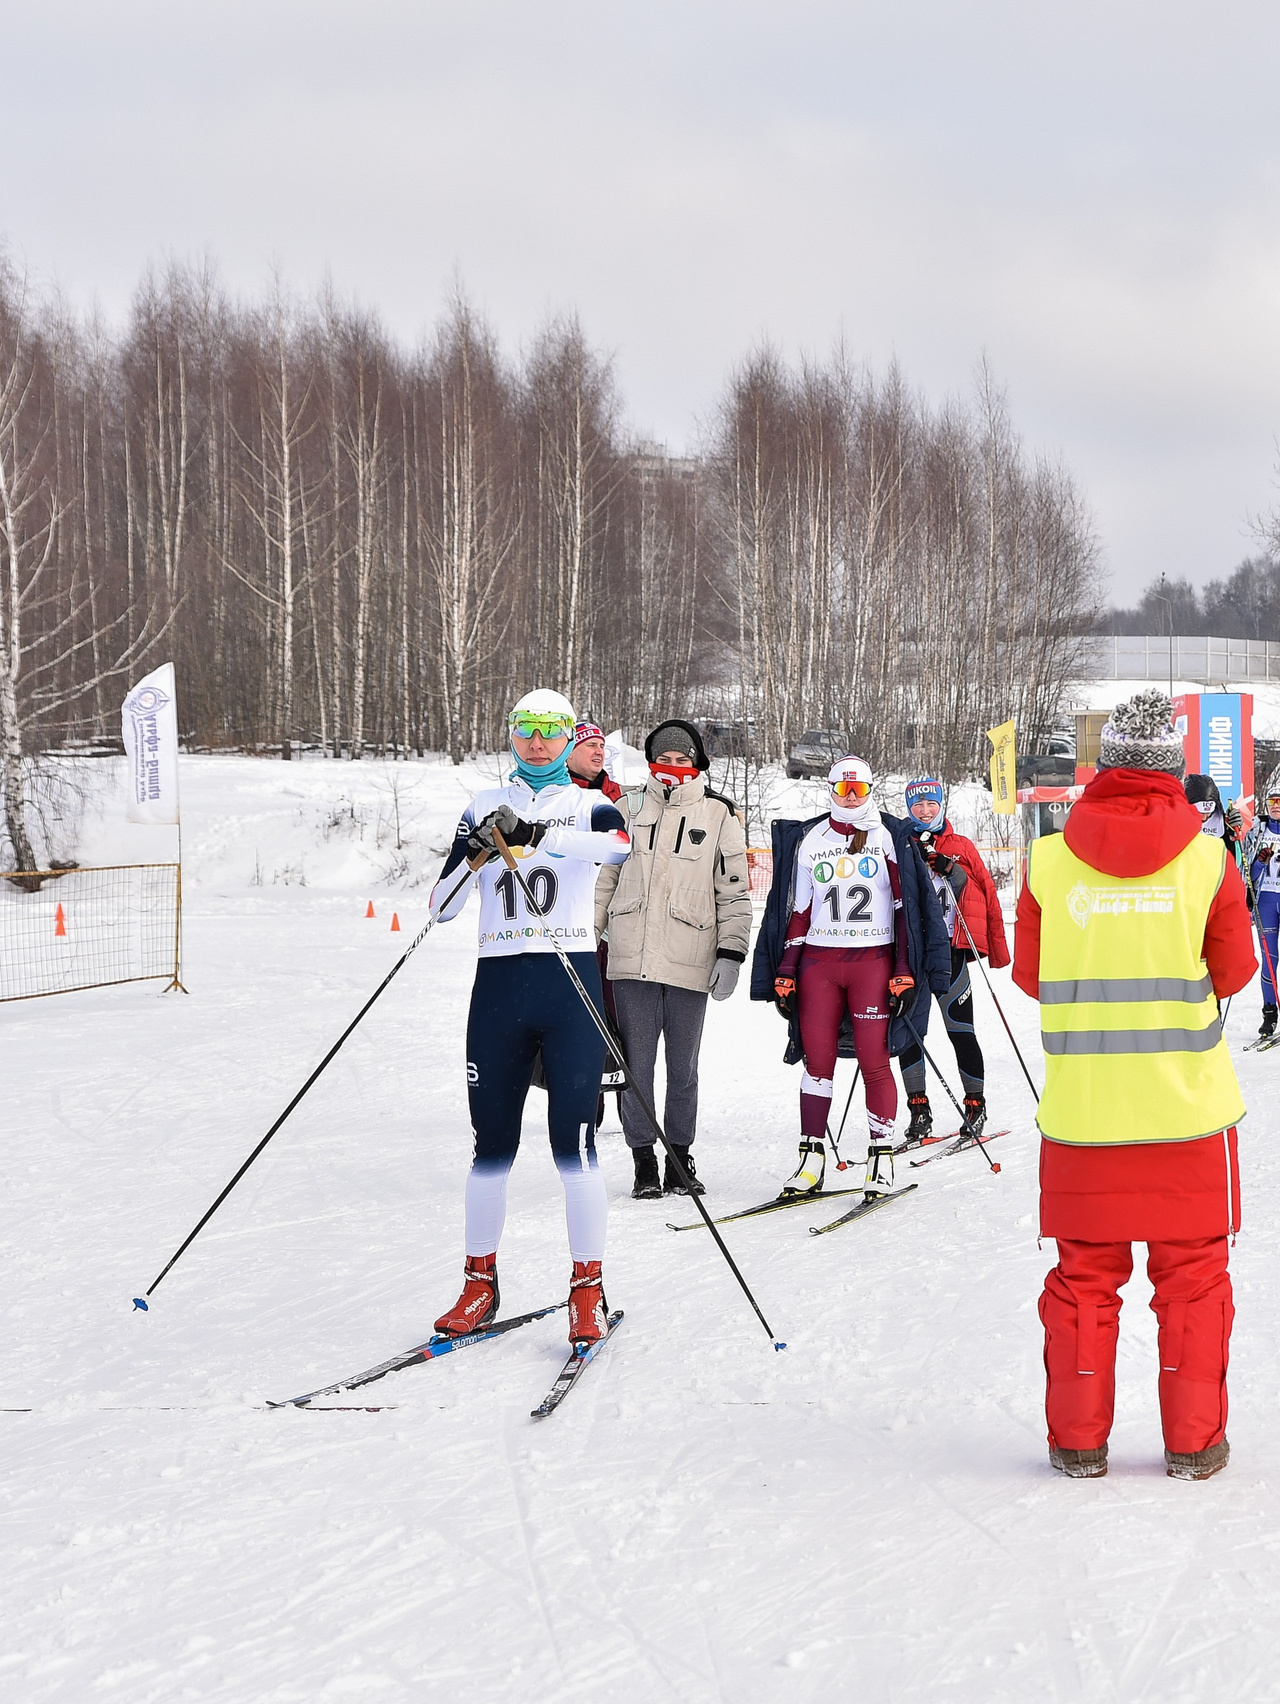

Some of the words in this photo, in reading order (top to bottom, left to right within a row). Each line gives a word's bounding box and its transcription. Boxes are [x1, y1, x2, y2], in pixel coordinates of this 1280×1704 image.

[1208, 716, 1233, 787] ФИНИШ
[907, 785, 937, 799] LUKOIL
[1048, 802, 1074, 815] ФИ
[809, 847, 880, 861] VMARAONE
[494, 866, 559, 920] 10
[822, 884, 873, 922] 12
[1093, 898, 1174, 916] Альфа-Битца
[608, 1072, 620, 1083] 12
[464, 1292, 489, 1316] alpina
